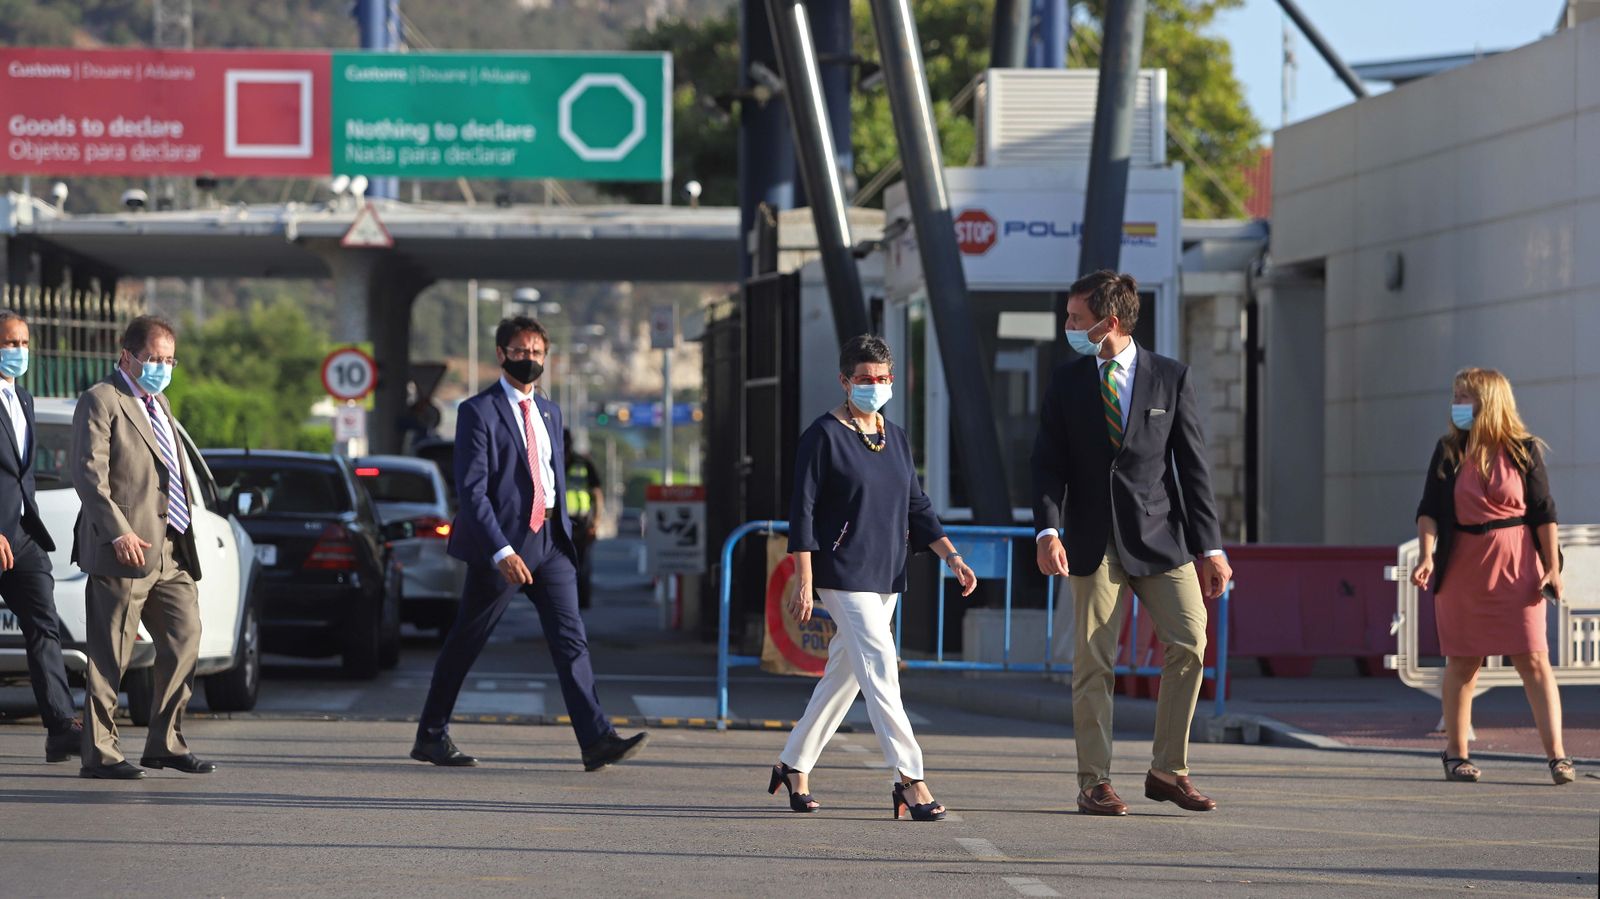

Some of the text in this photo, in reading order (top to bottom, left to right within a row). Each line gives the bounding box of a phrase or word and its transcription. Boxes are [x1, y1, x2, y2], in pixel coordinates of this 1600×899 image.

[9, 61, 195, 80] Customs Douane Aduana
[345, 65, 531, 84] Customs Douane Aduana
[9, 115, 184, 138] Goods to declare
[345, 119, 536, 145] Nothing to declare
[9, 138, 203, 165] Objetos para declarar
[345, 144, 518, 168] Nada para declarar
[954, 221, 994, 243] STOP
[1004, 221, 1085, 238] POLI
[334, 361, 367, 388] 10
